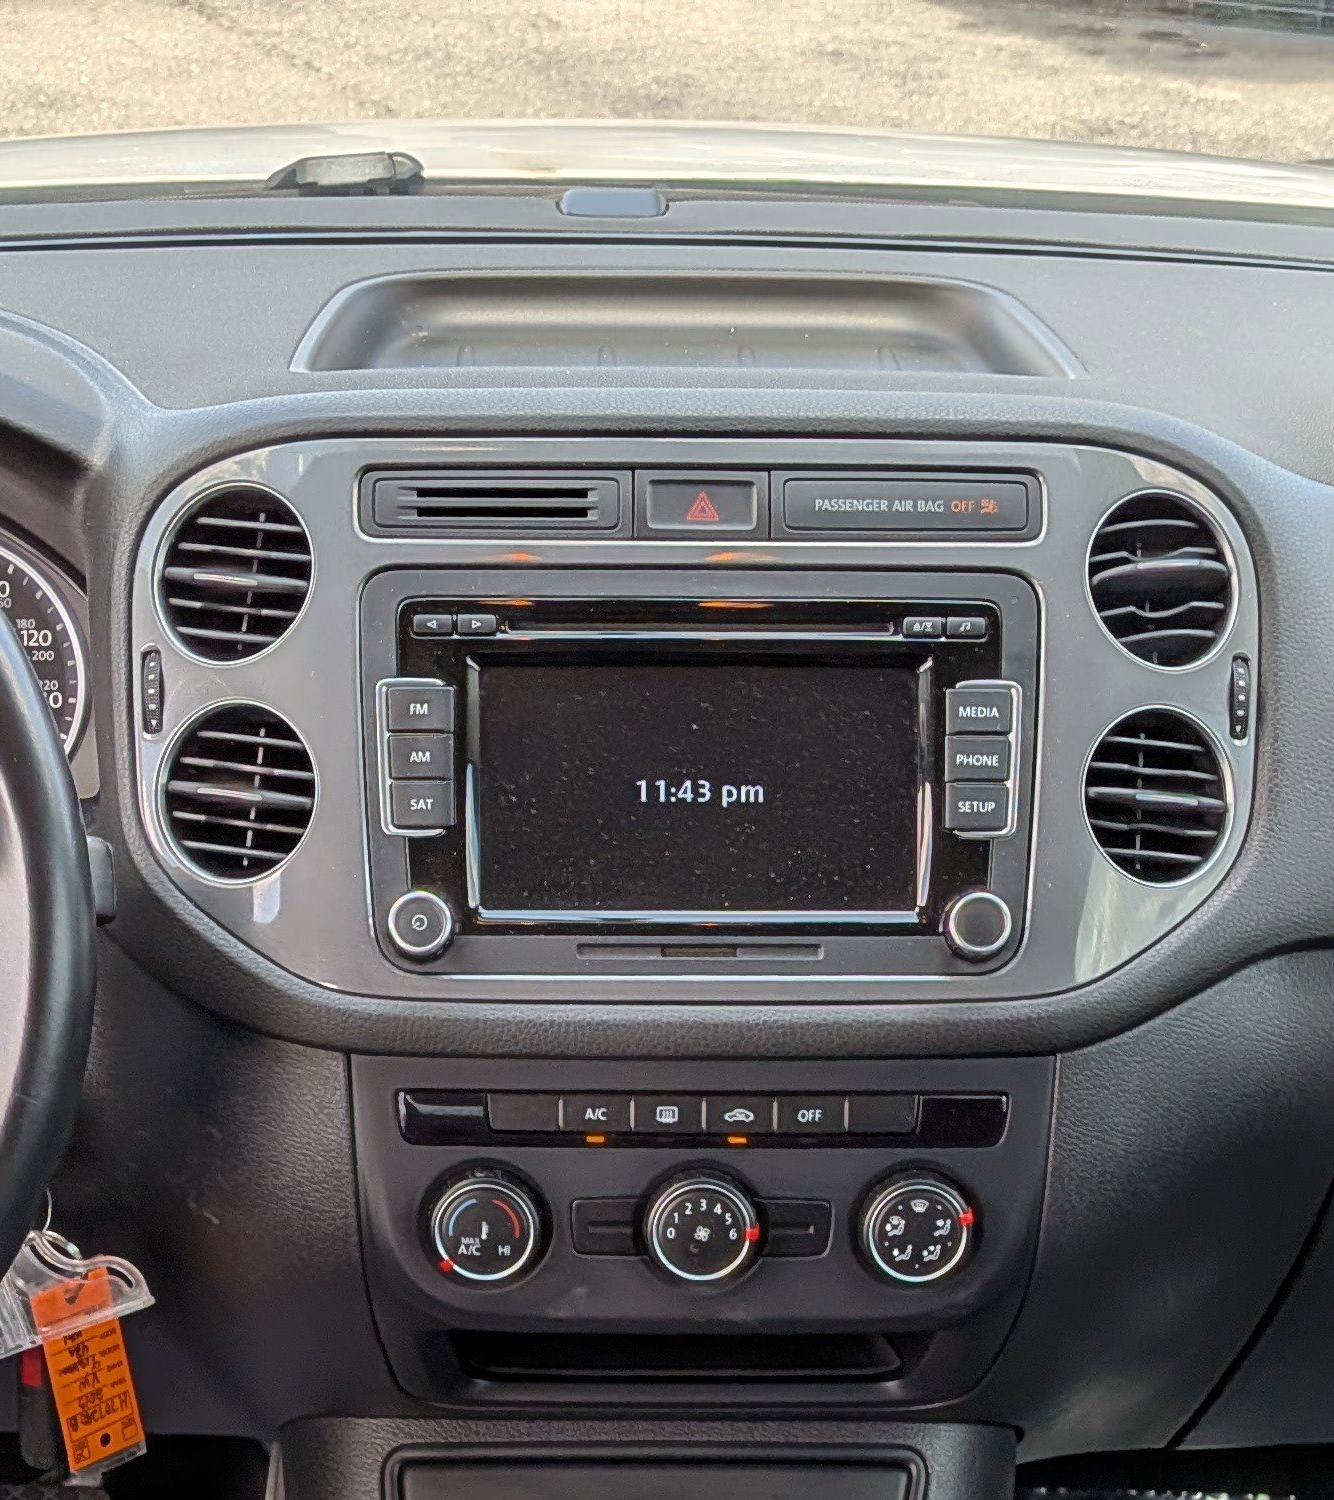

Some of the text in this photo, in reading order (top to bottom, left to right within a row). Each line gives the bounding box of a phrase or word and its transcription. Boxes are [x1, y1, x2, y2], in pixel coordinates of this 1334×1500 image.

[814, 499, 975, 512] PASSENGER AIR BAG OFF
[20, 629, 52, 647] 120
[409, 703, 428, 715] FM
[958, 706, 1000, 718] MEDIA
[409, 751, 431, 763] AM
[956, 754, 999, 767] PHONE
[635, 779, 764, 808] 11:43 pm
[410, 799, 434, 811] SAT
[958, 801, 996, 813] SETUP
[584, 1108, 608, 1121] A/C
[797, 1109, 823, 1122] OFF
[685, 1202, 692, 1215] 2
[700, 1199, 707, 1211] 3
[713, 1202, 722, 1215] 4
[673, 1212, 679, 1224] 1
[725, 1212, 732, 1225] 5
[667, 1227, 676, 1239] 0
[729, 1228, 737, 1240] 6
[461, 1237, 480, 1245] MAX
[458, 1245, 481, 1256] A/C
[498, 1245, 511, 1256] HI
